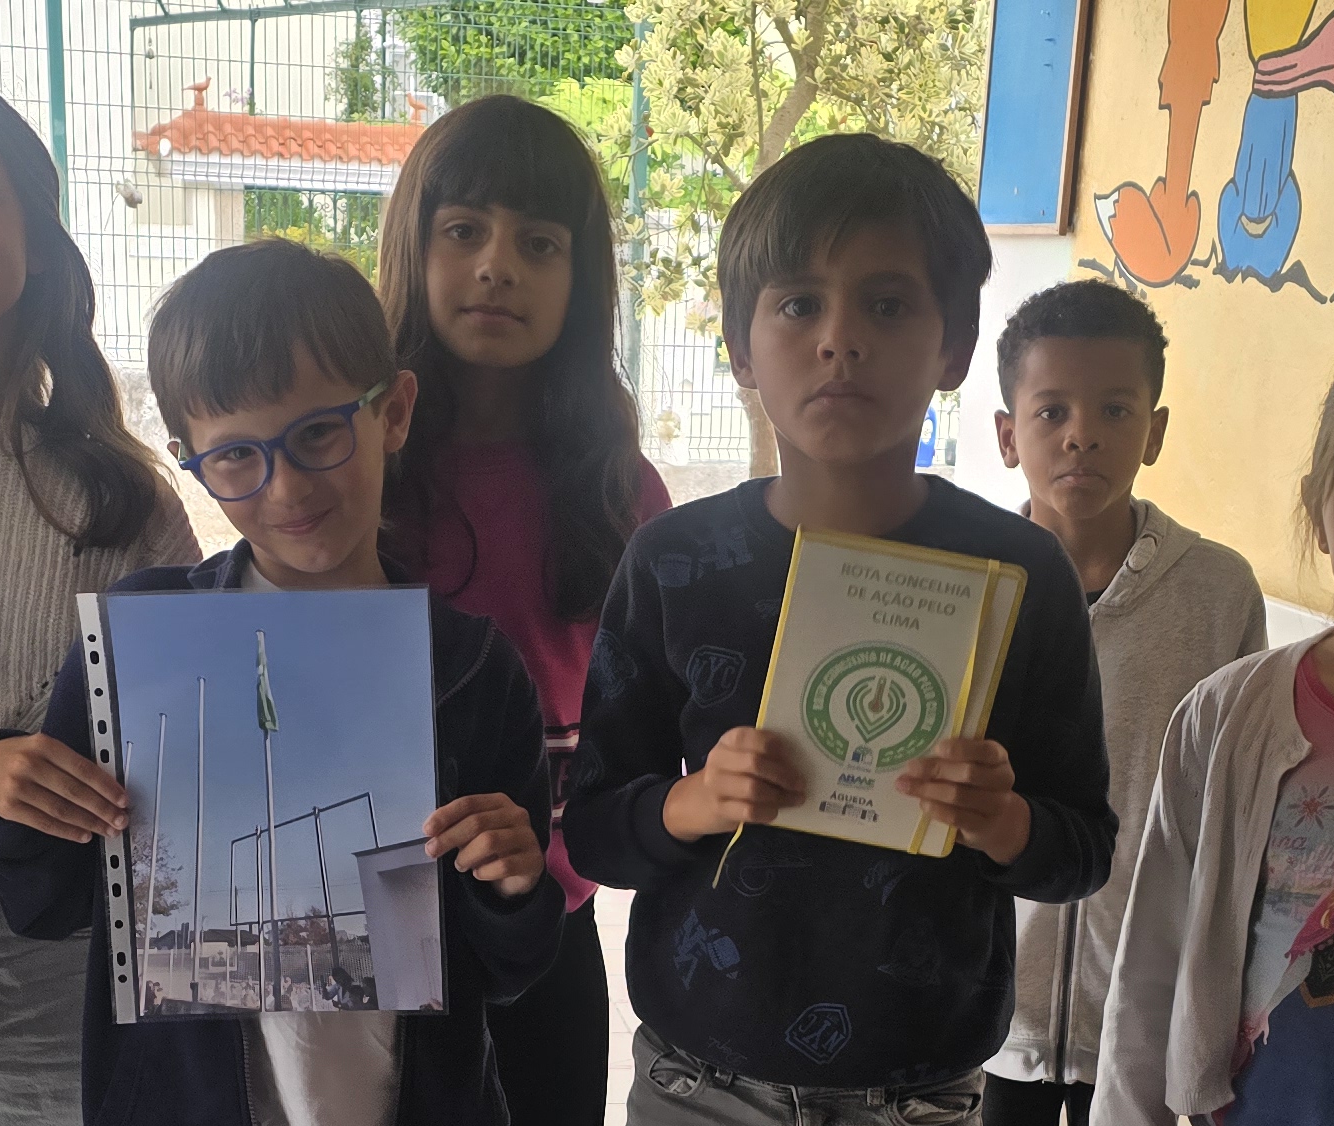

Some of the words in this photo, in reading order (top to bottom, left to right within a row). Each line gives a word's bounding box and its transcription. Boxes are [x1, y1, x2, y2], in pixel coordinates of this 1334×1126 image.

[885, 570, 971, 599] CONCELHIA
[846, 584, 867, 601] DE
[870, 590, 914, 610] AÇÃO
[917, 598, 957, 617] PELO
[872, 610, 920, 631] CLIMA
